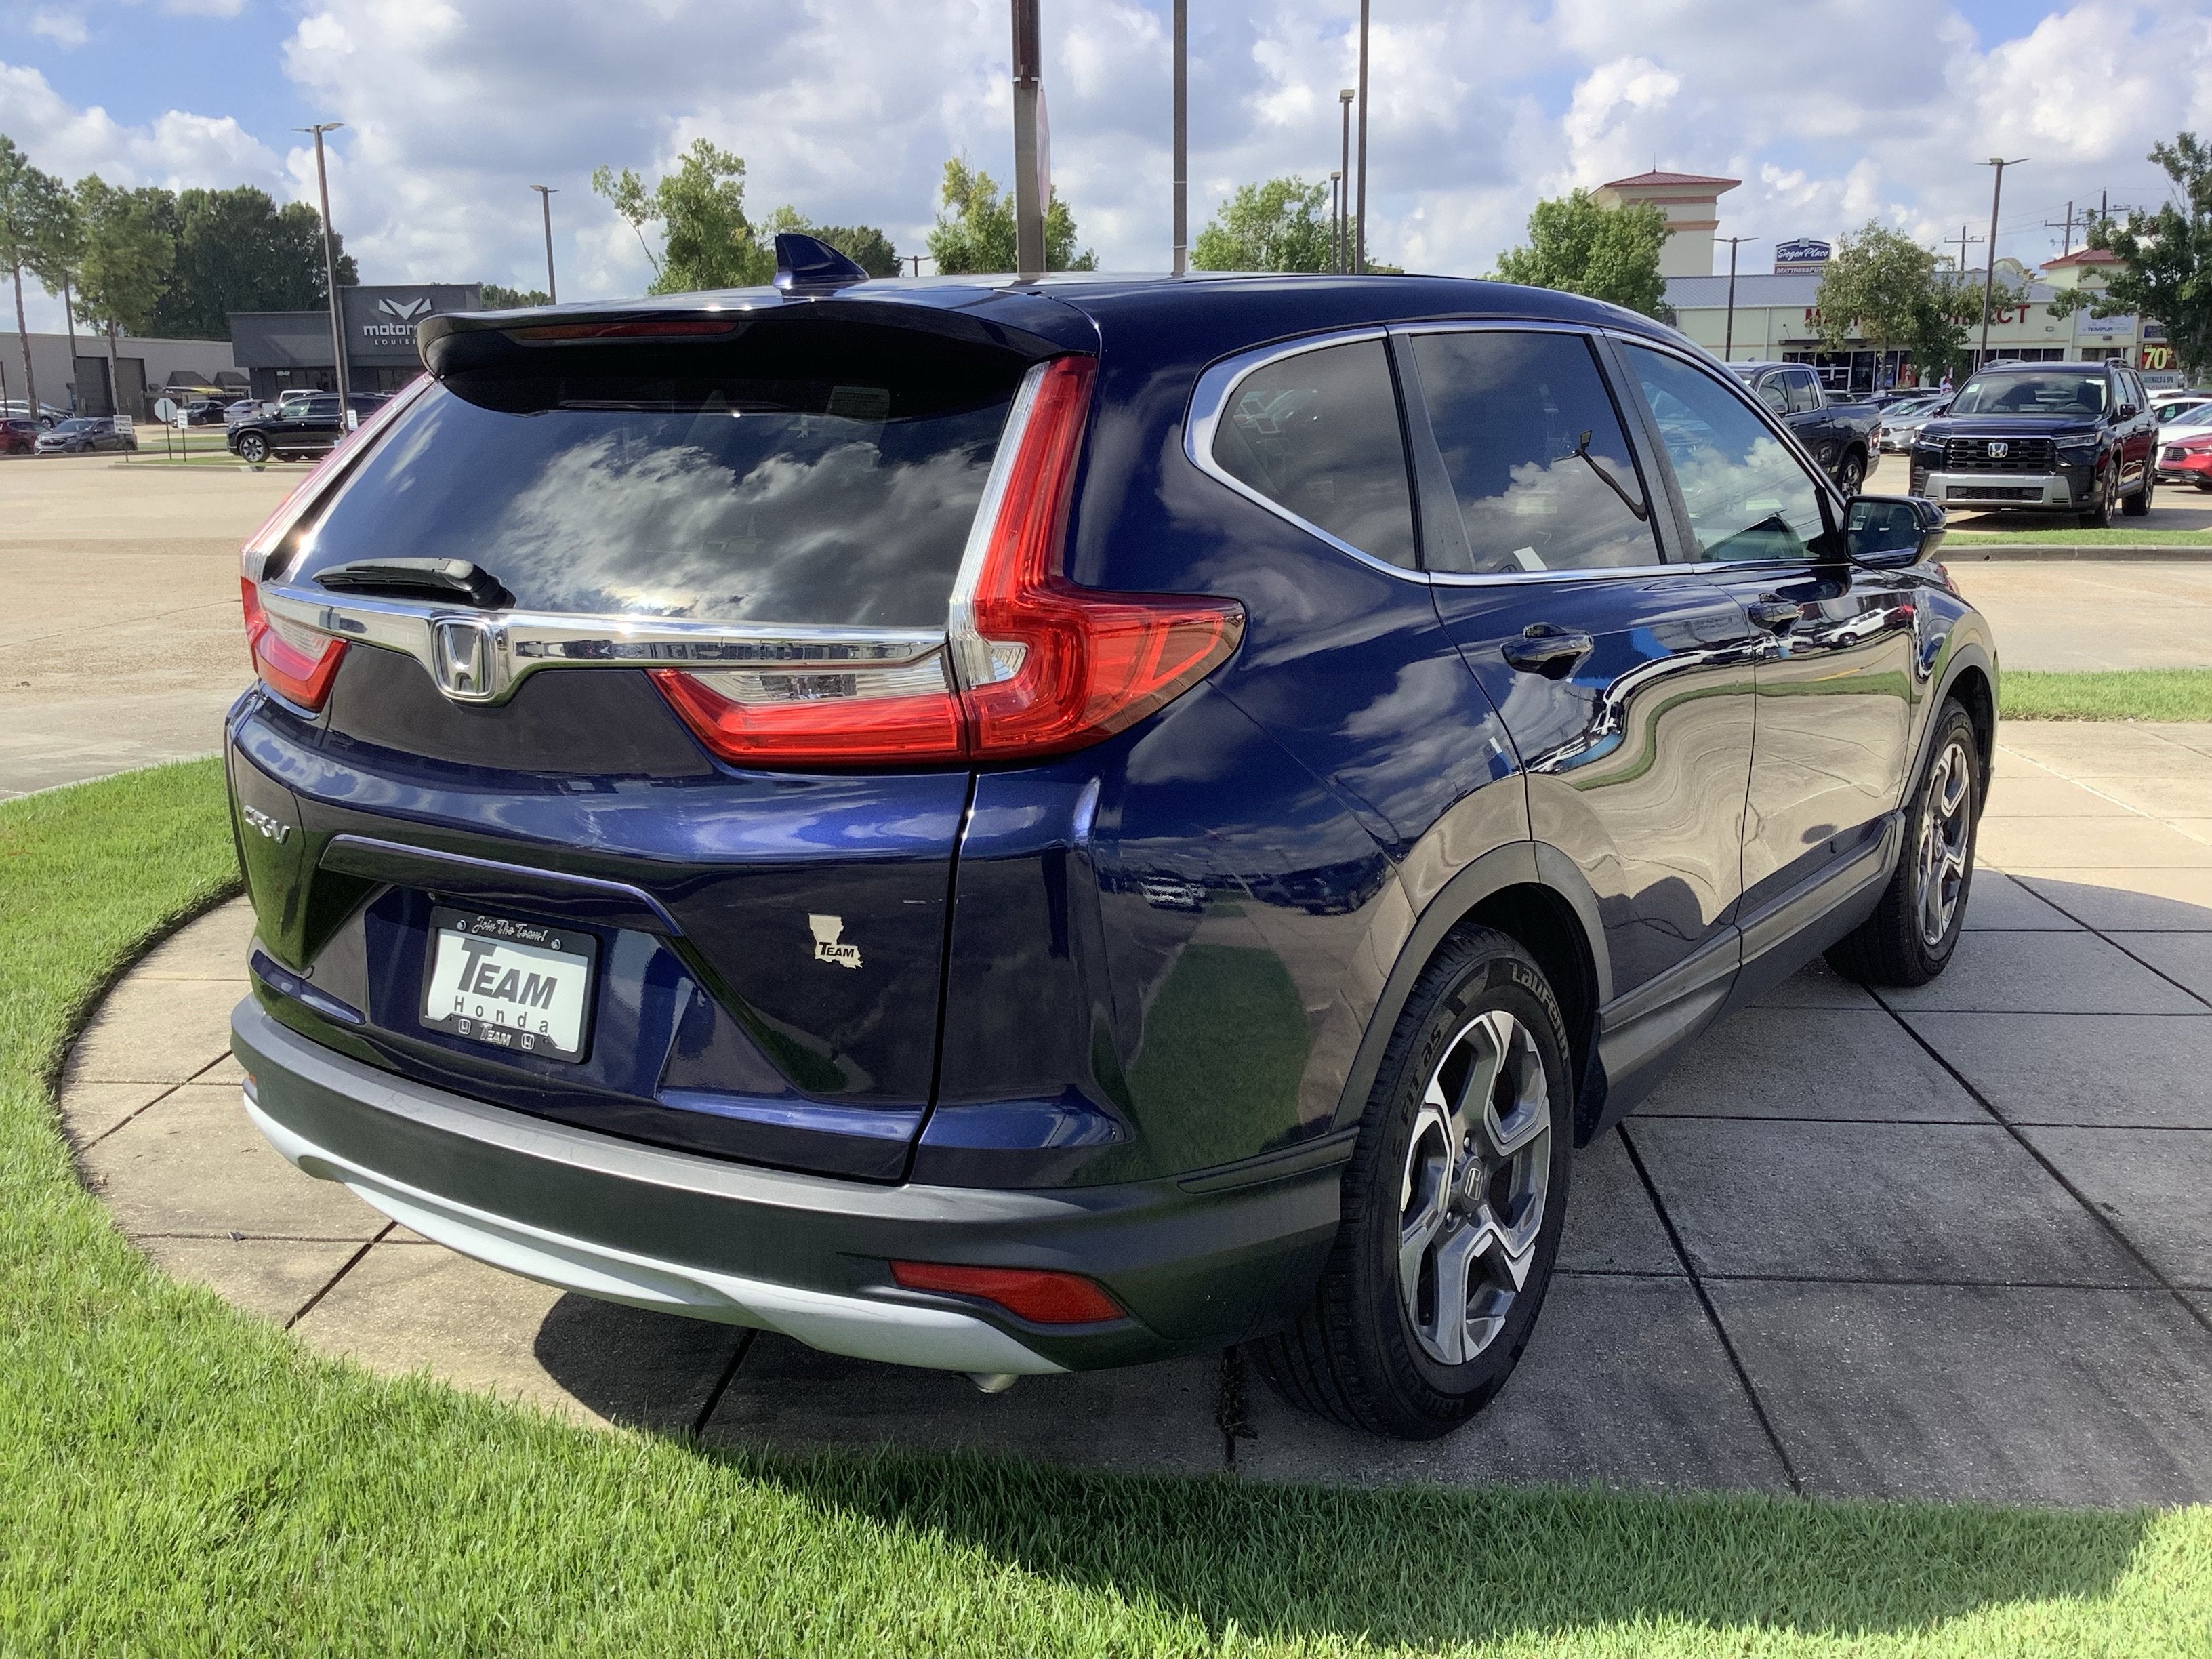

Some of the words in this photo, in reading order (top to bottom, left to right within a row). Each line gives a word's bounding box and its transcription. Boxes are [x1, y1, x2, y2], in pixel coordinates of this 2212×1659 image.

[1778, 248, 1803, 261] Siegen
[1803, 247, 1829, 258] Place
[363, 323, 417, 336] motor
[472, 916, 496, 934] Join
[496, 920, 515, 936] The
[516, 923, 548, 942] Team!
[819, 941, 855, 958] TEAM
[457, 939, 558, 1010] TEAM
[480, 1023, 512, 1046] TEAM
